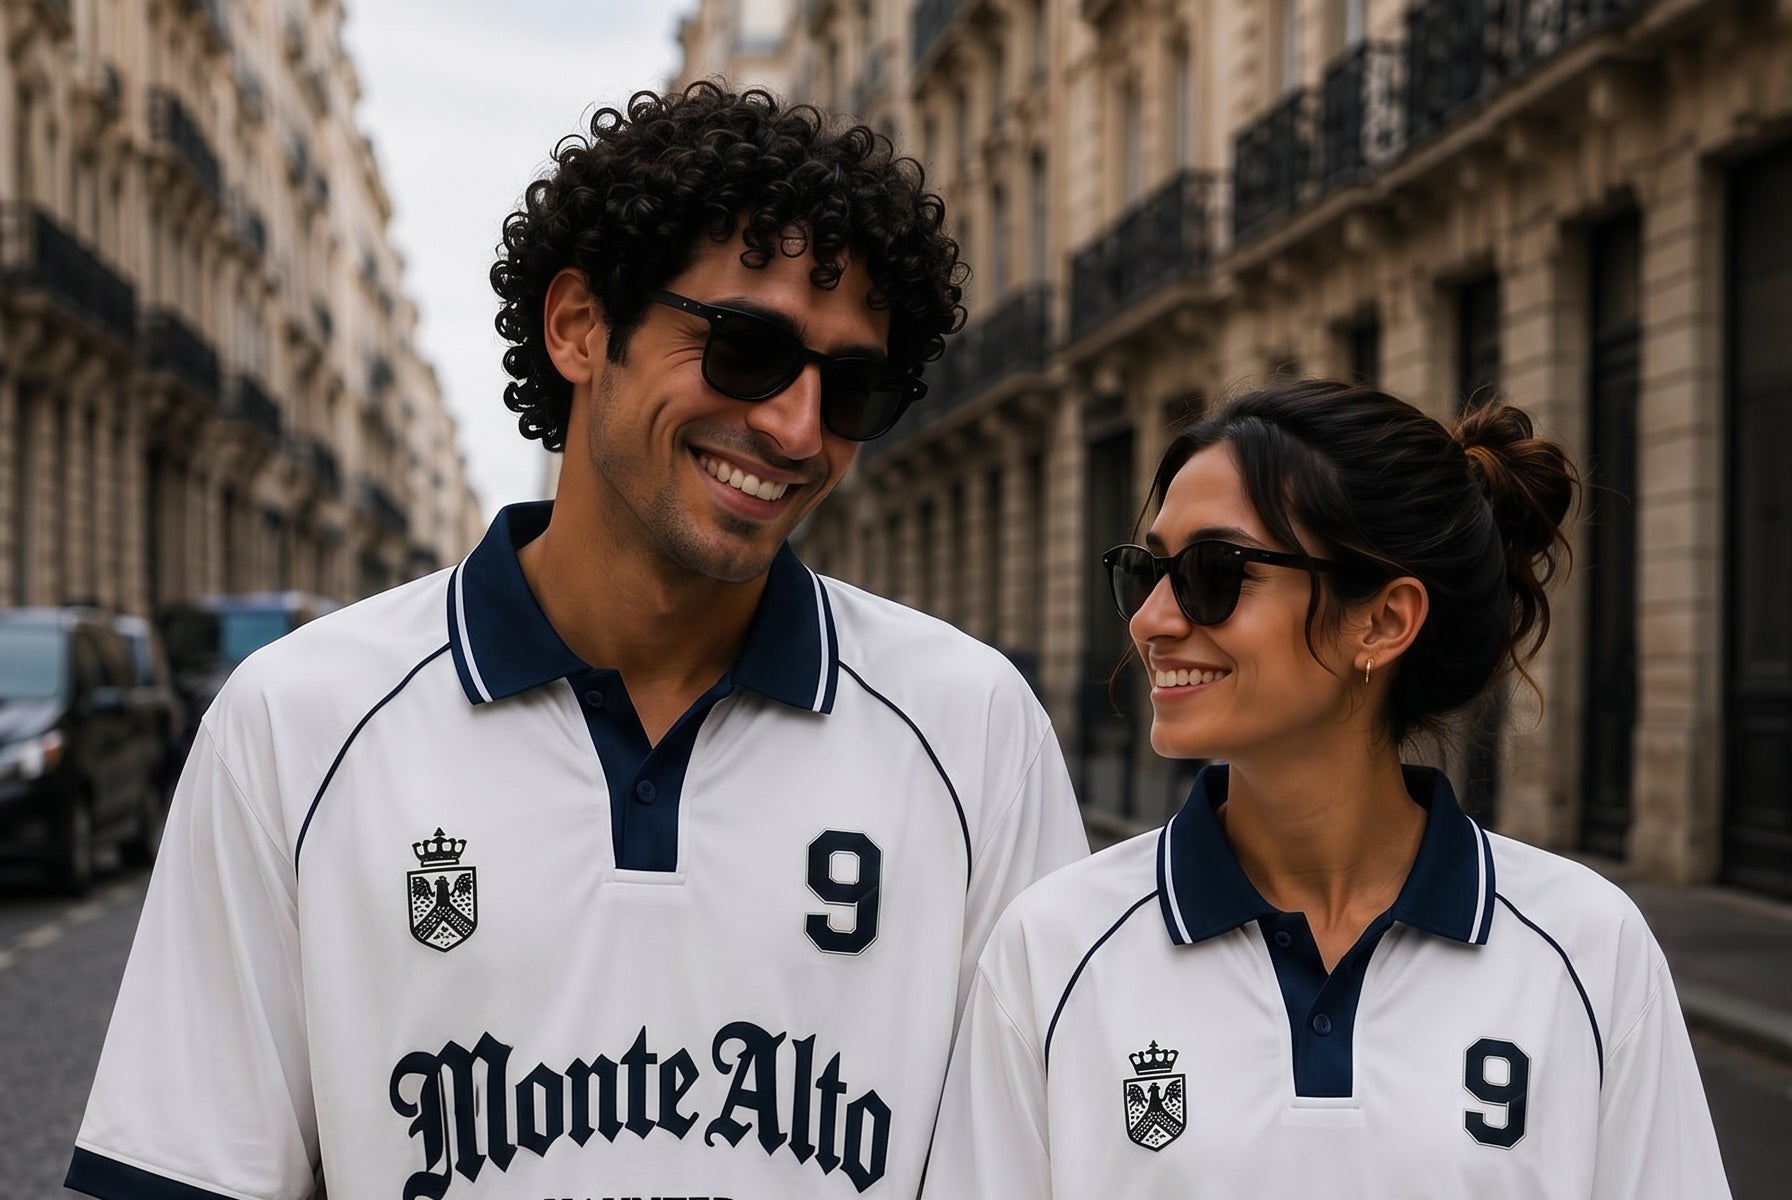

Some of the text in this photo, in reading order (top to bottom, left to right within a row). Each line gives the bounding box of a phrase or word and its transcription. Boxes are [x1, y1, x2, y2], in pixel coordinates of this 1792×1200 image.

[803, 829, 882, 957] 9
[704, 1020, 892, 1194] Alto
[1462, 1037, 1530, 1151] 9
